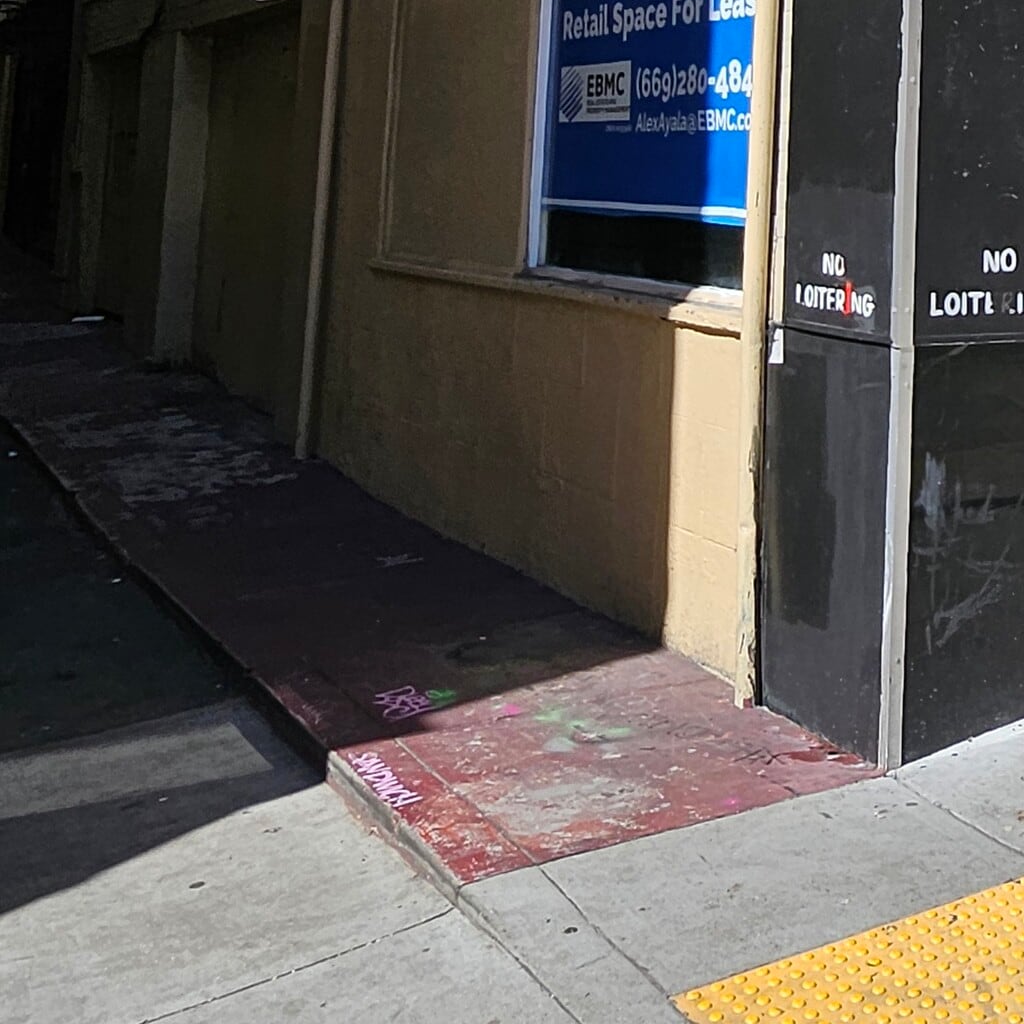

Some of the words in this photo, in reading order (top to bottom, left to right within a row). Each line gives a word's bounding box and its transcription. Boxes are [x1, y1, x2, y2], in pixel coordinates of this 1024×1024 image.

[563, 4, 608, 41] Retail
[612, 2, 667, 42] Space
[586, 72, 625, 97] EBMC
[636, 59, 753, 103] (669)280-484
[635, 108, 751, 137] AlexAyala@EBMC.co
[822, 252, 845, 276] NO
[983, 247, 1017, 273] NO
